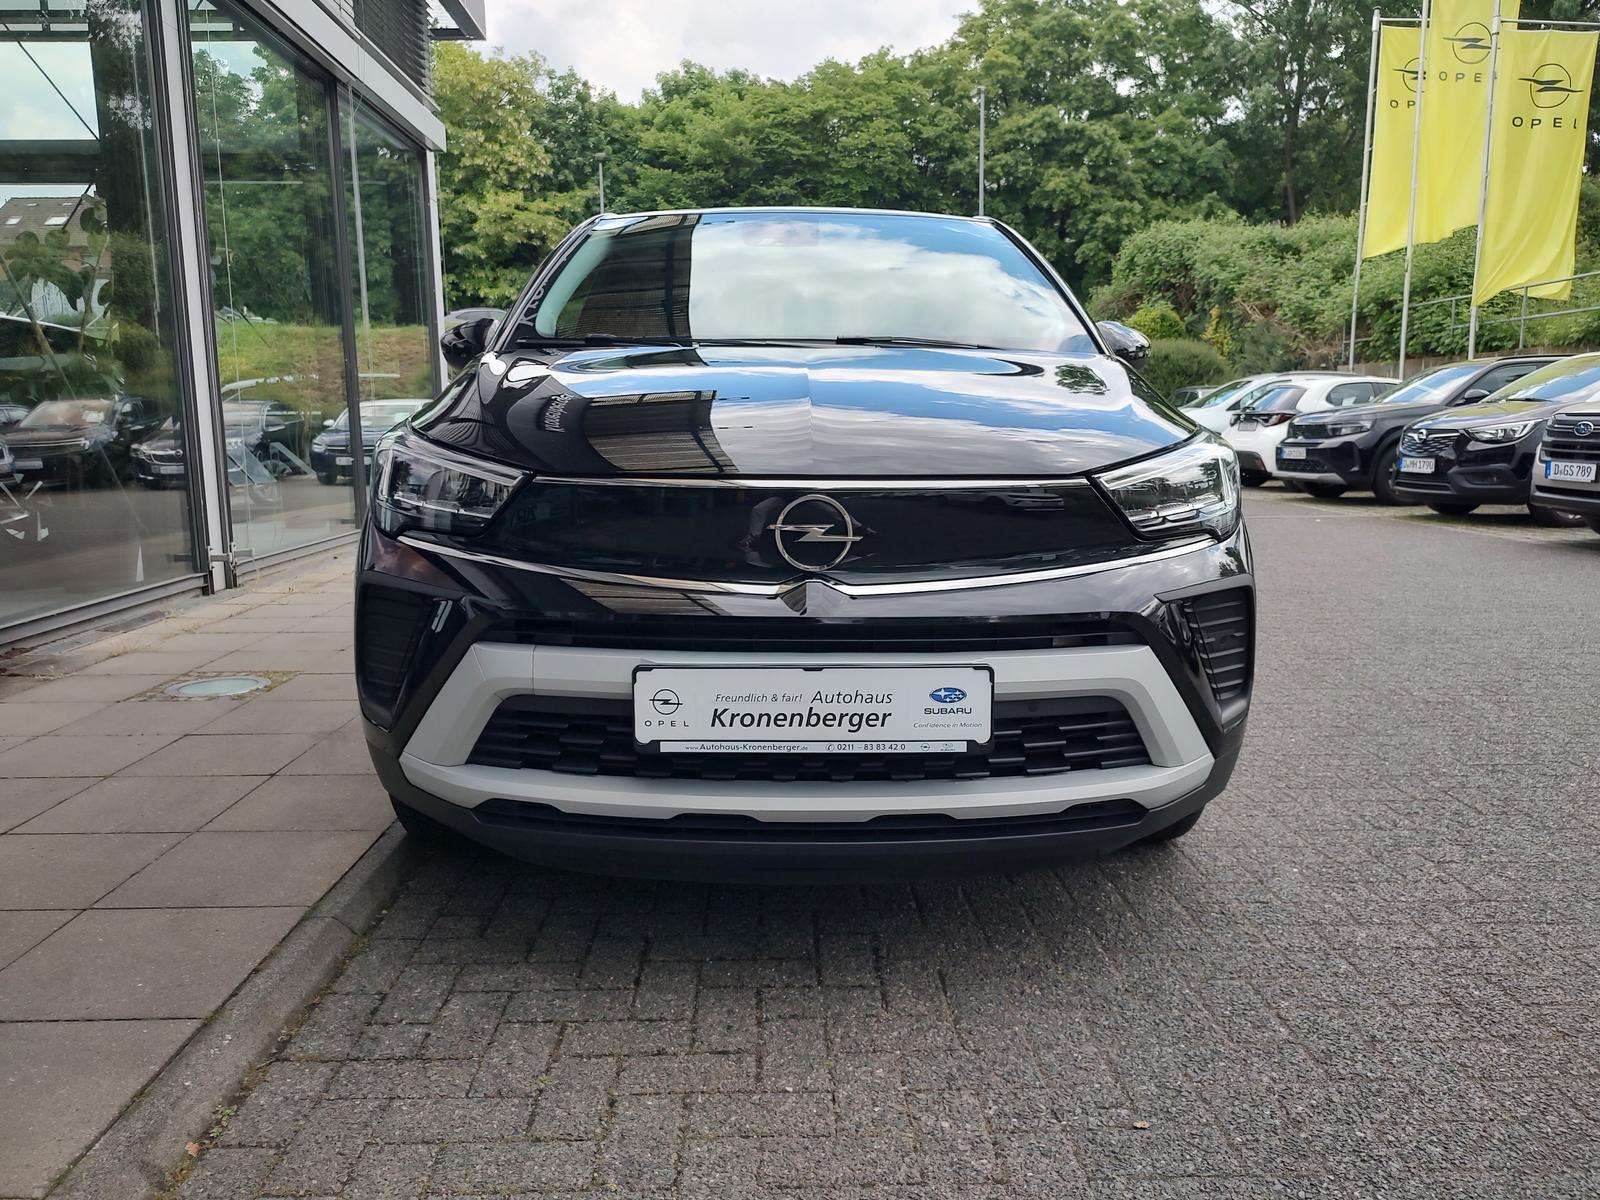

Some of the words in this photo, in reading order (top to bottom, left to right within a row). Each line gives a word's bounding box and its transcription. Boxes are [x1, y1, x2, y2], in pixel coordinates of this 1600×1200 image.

[1389, 99, 1416, 109] OP
[715, 693, 768, 703] Freundlich
[770, 694, 778, 703] &
[781, 693, 803, 703] fair!
[810, 690, 893, 704] Autohaus
[924, 707, 972, 715] SUBARU
[710, 707, 892, 733] Kronenberger
[837, 743, 854, 751] 0211
[864, 743, 874, 751] 83
[876, 743, 886, 751] 83
